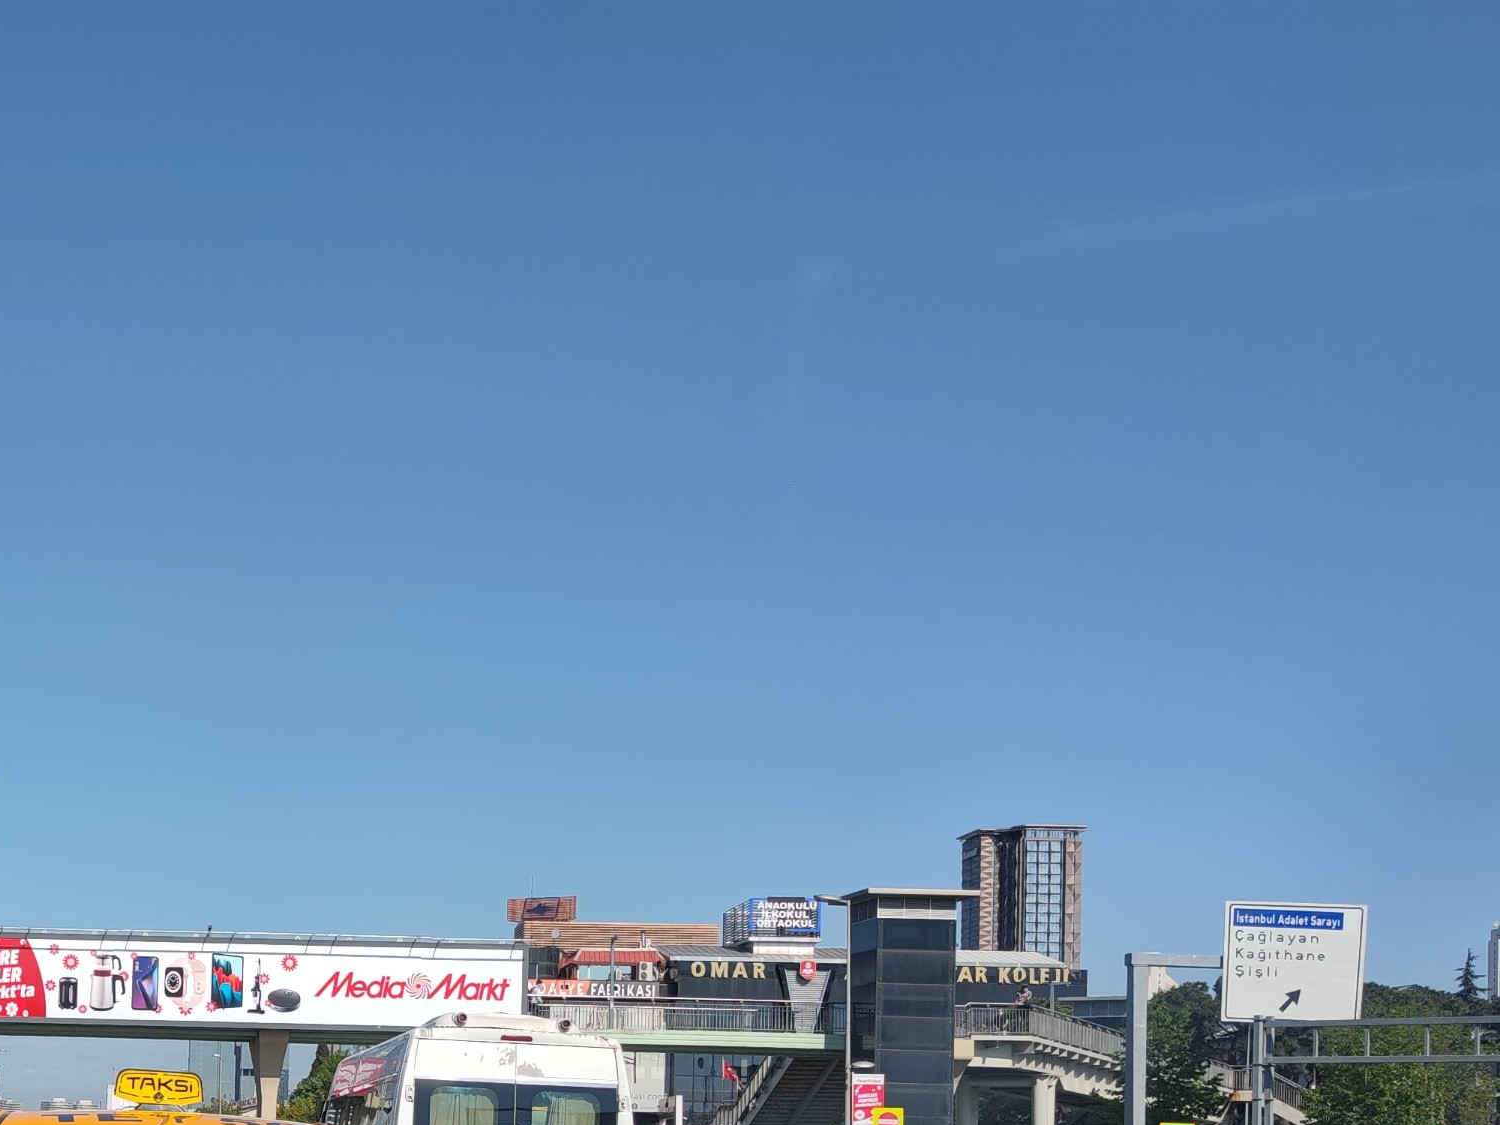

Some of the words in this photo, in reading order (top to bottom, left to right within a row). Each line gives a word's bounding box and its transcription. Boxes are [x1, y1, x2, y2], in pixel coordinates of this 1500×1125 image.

[757, 901, 818, 910] ANAOKULU
[756, 919, 816, 928] ORTAOKUL
[1236, 910, 1275, 924] İstanbul
[1277, 914, 1309, 926] Adalet
[1310, 915, 1341, 929] Sarayı
[1235, 929, 1320, 946] Çağlayan
[1235, 947, 1326, 962] Kağıthane
[690, 961, 766, 979] OMAR
[1235, 965, 1279, 979] Şişli
[314, 970, 407, 999] Media
[426, 973, 510, 1001] Markt
